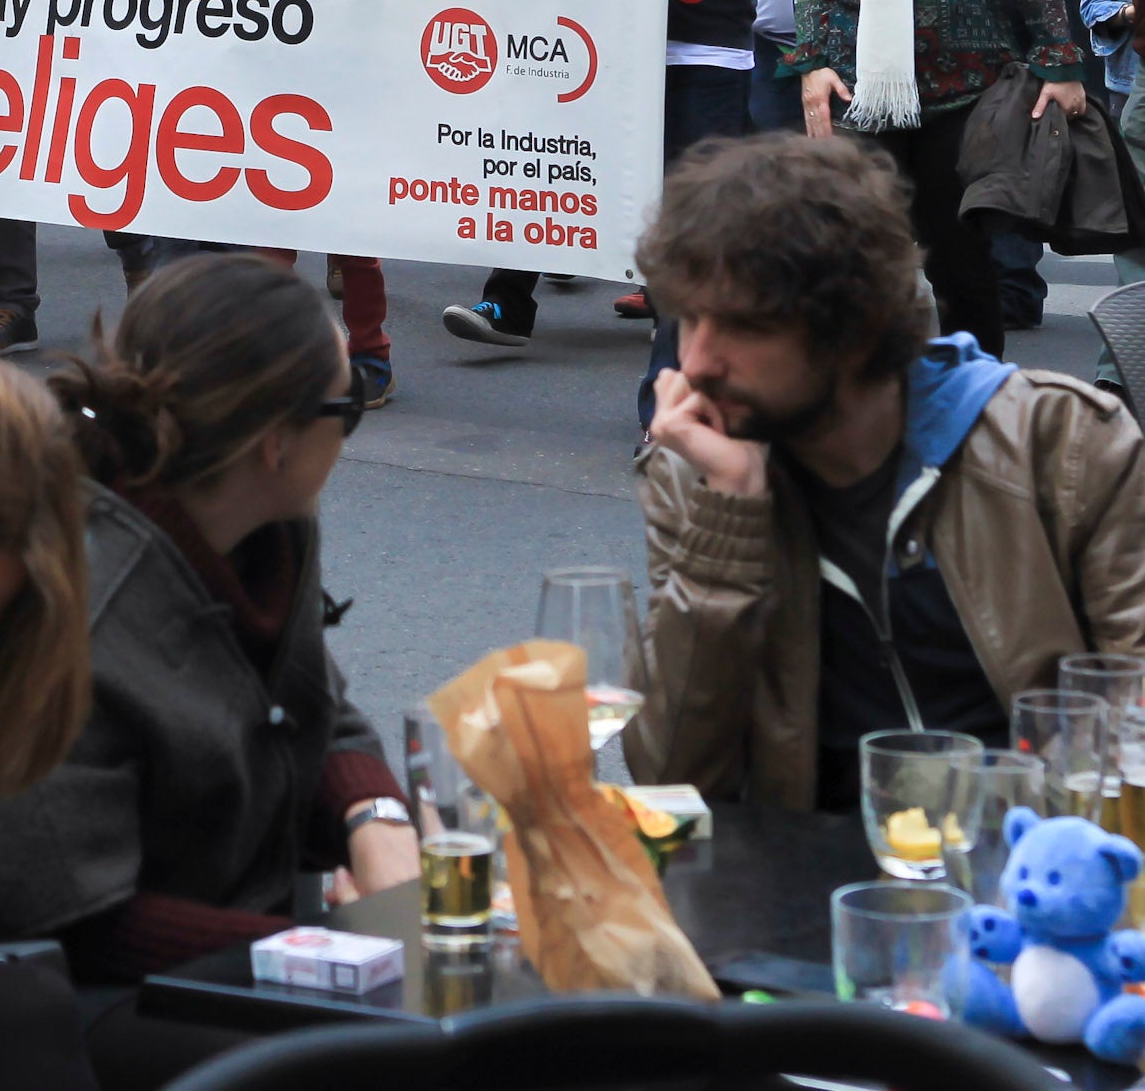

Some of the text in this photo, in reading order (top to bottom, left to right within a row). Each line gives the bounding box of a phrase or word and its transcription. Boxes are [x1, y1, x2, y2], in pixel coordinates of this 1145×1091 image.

[430, 21, 489, 57] UGT
[507, 34, 569, 63] MCA
[528, 66, 570, 79] Industria
[437, 123, 597, 160] Por la Industria,
[483, 159, 597, 186] por el país,
[389, 177, 598, 216] ponte manos
[457, 212, 598, 249] a la obra
